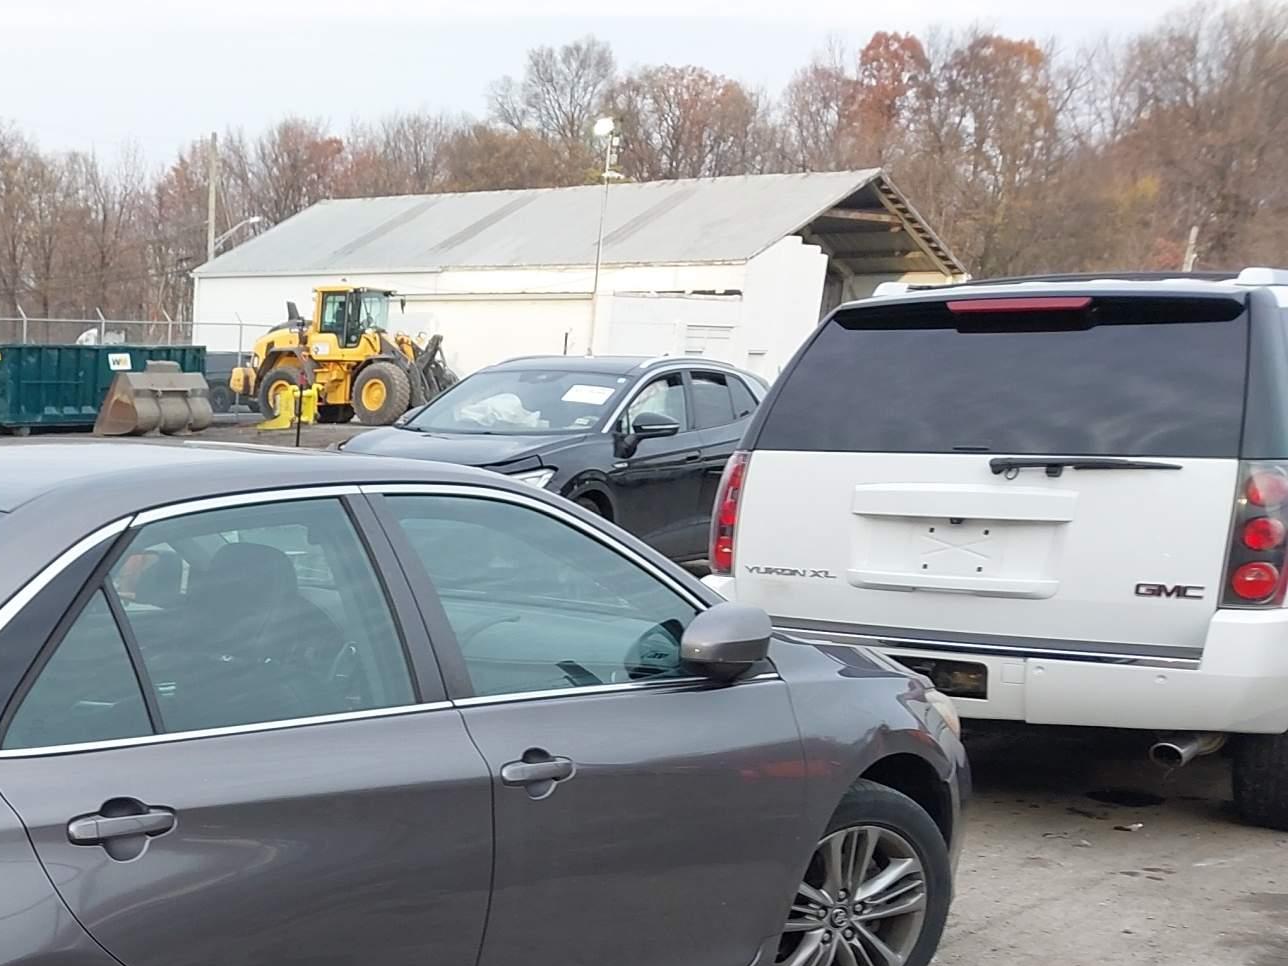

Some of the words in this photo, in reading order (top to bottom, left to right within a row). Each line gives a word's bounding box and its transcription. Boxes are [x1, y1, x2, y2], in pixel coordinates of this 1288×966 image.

[744, 565, 807, 577] YUKON
[809, 569, 837, 578] XL
[1135, 583, 1205, 599] GMC
